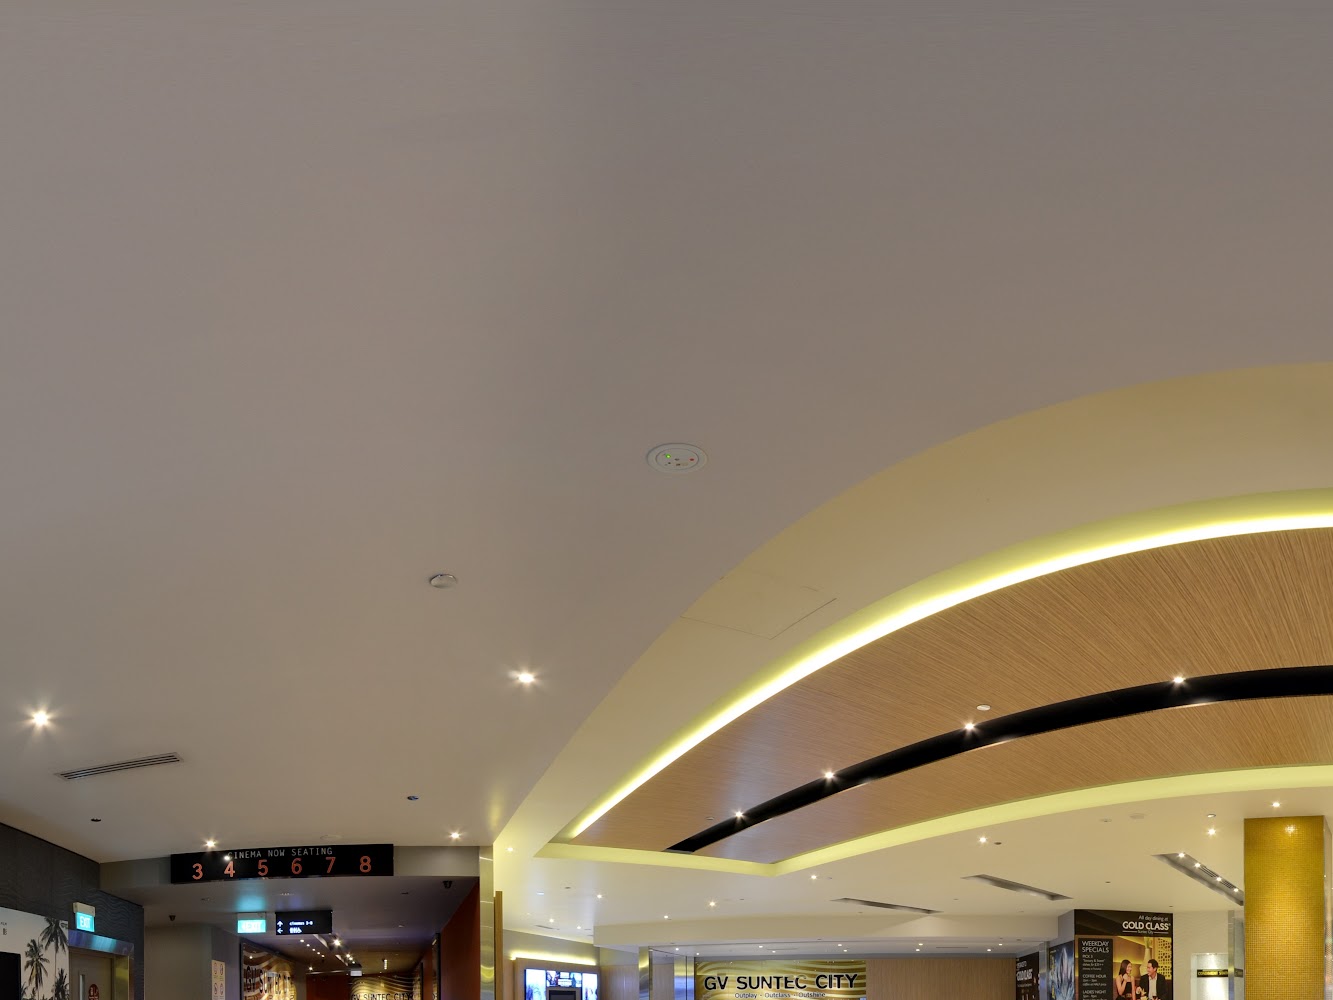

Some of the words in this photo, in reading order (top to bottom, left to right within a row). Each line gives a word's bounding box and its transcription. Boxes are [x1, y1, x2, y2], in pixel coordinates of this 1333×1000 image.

[228, 850, 262, 859] CINEMA
[268, 849, 285, 857] NOW
[291, 847, 333, 856] SEATING
[192, 863, 204, 880] 3
[224, 860, 236, 877] 4
[258, 859, 269, 876] 5
[291, 858, 302, 875] 6
[326, 856, 336, 874] 7
[359, 856, 372, 873] 8
[1122, 921, 1144, 930] GOLD
[704, 976, 728, 990] GV
[736, 975, 807, 990] SUNTEC
[815, 974, 858, 989] CITY
